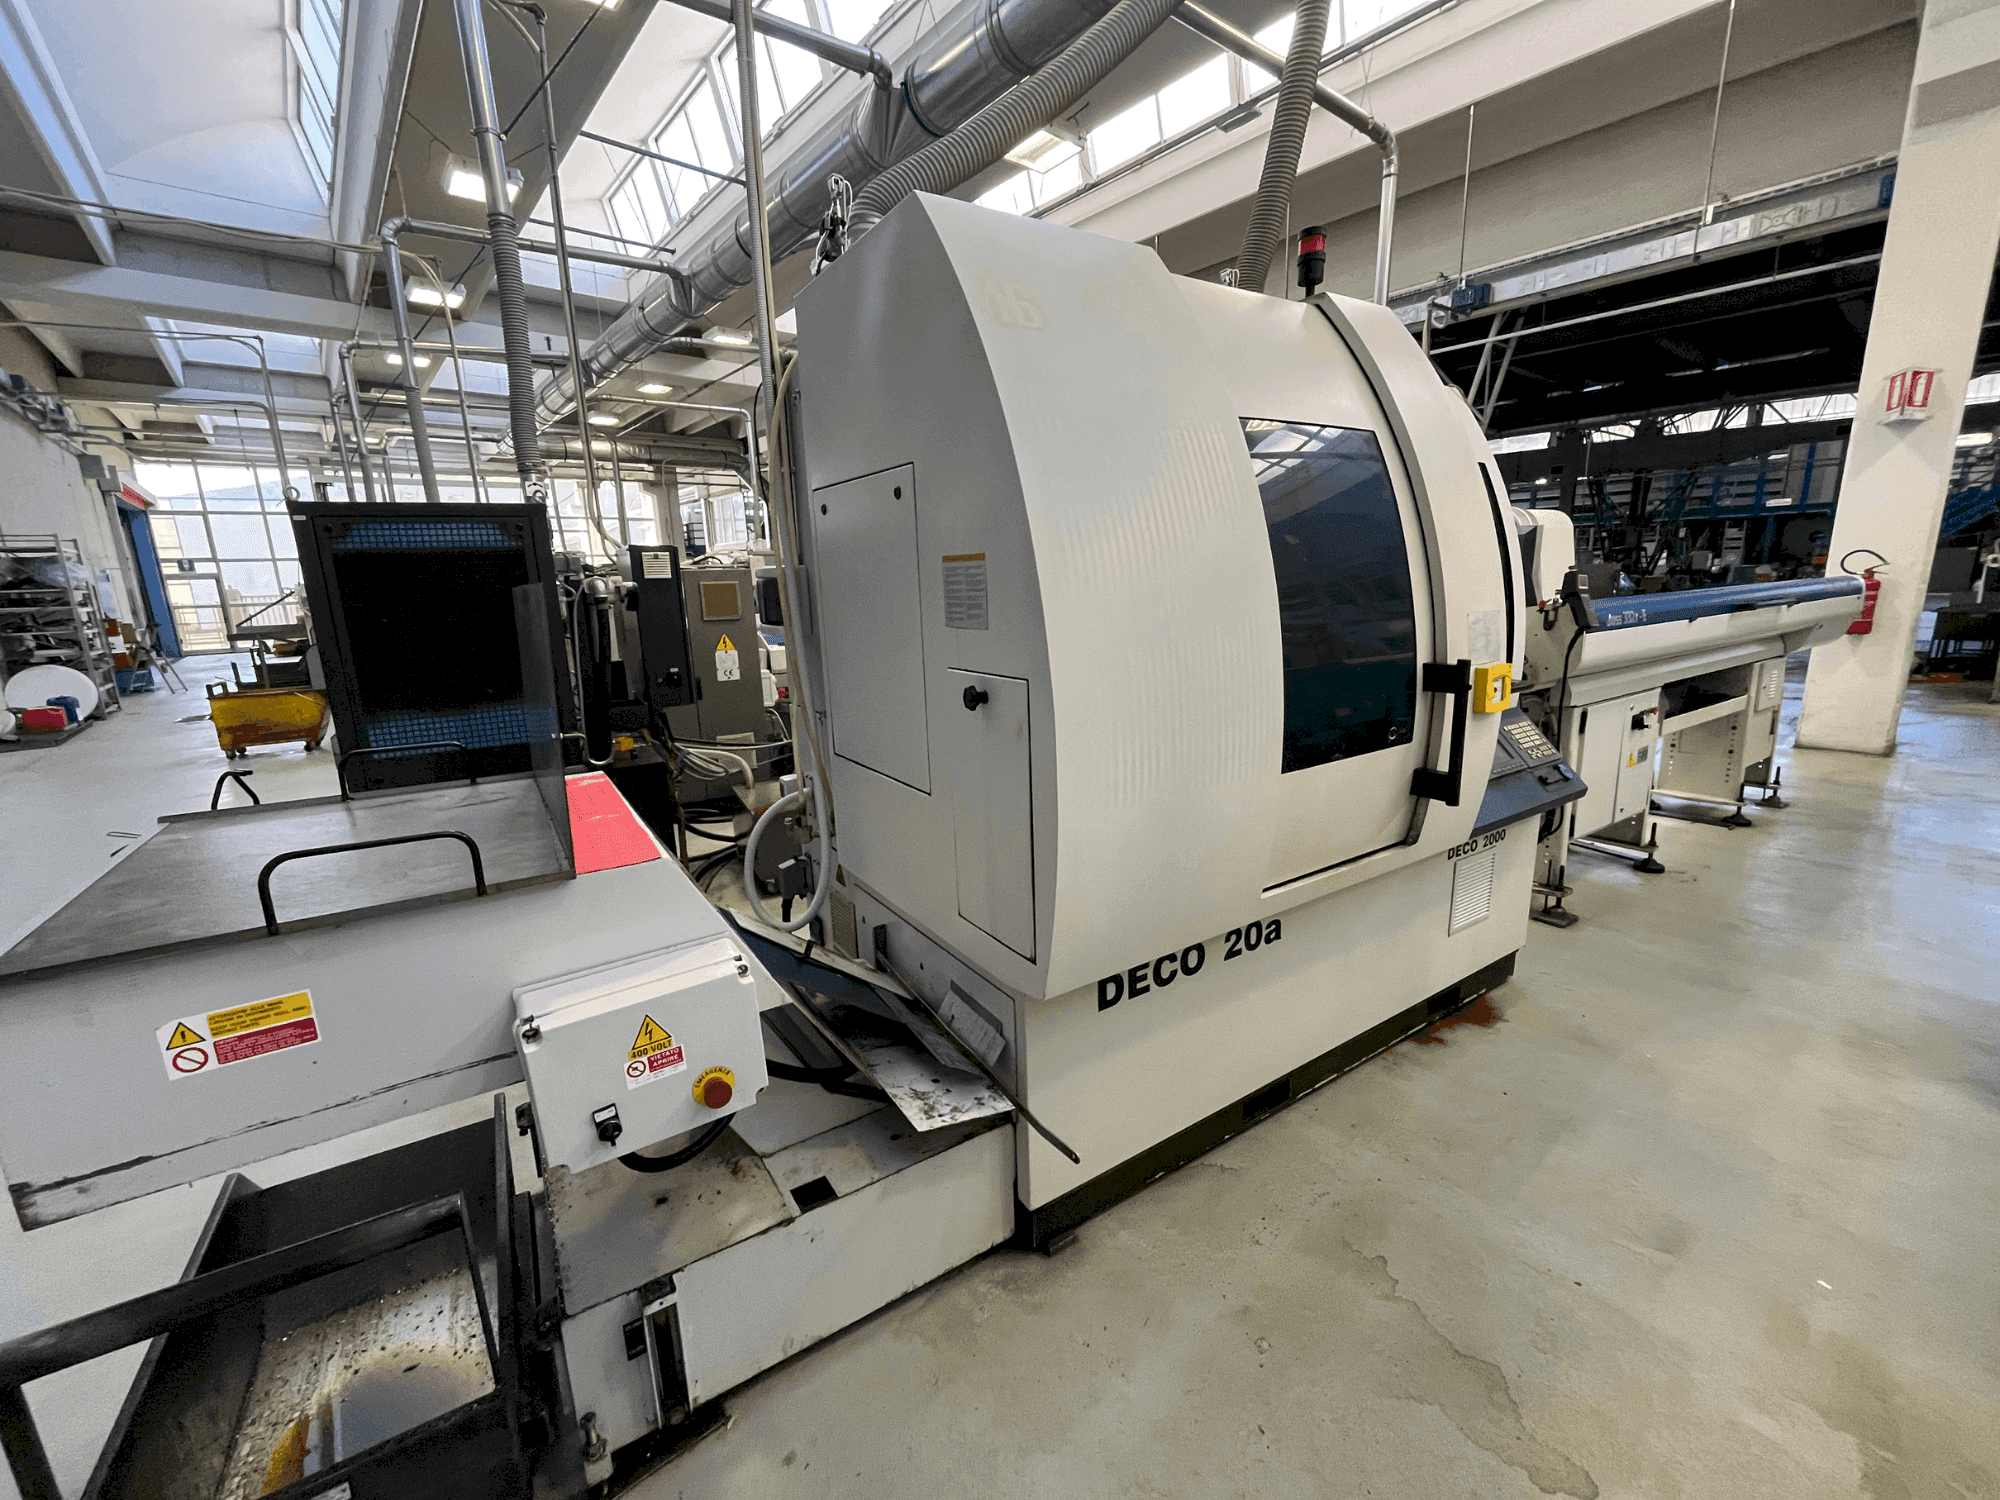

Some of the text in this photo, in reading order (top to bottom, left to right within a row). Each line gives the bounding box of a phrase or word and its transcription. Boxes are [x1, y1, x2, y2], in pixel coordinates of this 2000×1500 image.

[1447, 828, 1506, 860] DECO 2000
[1097, 918, 1282, 1013] DECO 20a
[631, 1038, 673, 1060] 400 VOLT
[650, 1048, 679, 1061] VIETATO
[652, 1054, 679, 1067] APRIRE
[695, 1066, 730, 1088] EMERGENZA
